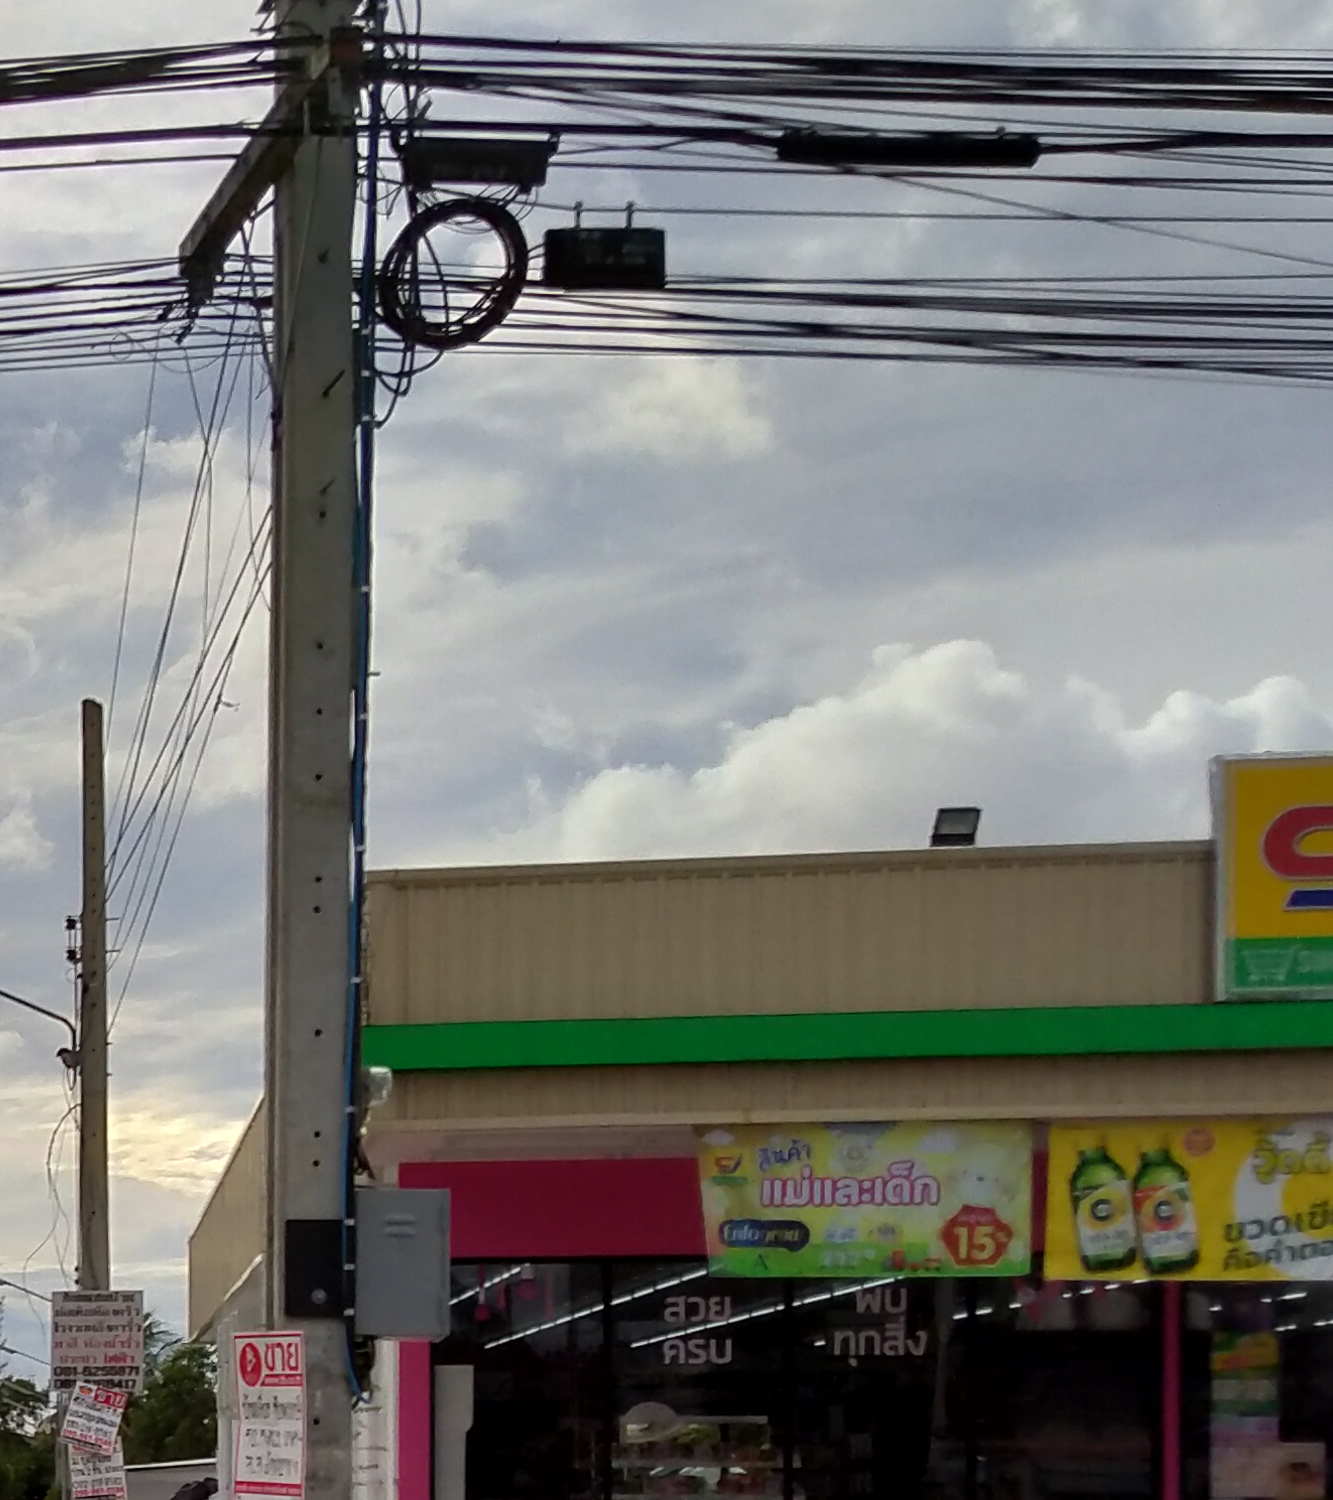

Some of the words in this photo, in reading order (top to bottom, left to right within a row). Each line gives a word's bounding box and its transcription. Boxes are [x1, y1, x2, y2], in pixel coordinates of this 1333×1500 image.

[761, 1160, 941, 1207] แม่และเด็ก
[663, 1296, 732, 1323] สวย
[663, 1338, 733, 1365] ครบ
[833, 1316, 929, 1367] ทุกสิ่ง
[264, 1342, 300, 1371] ขาย
